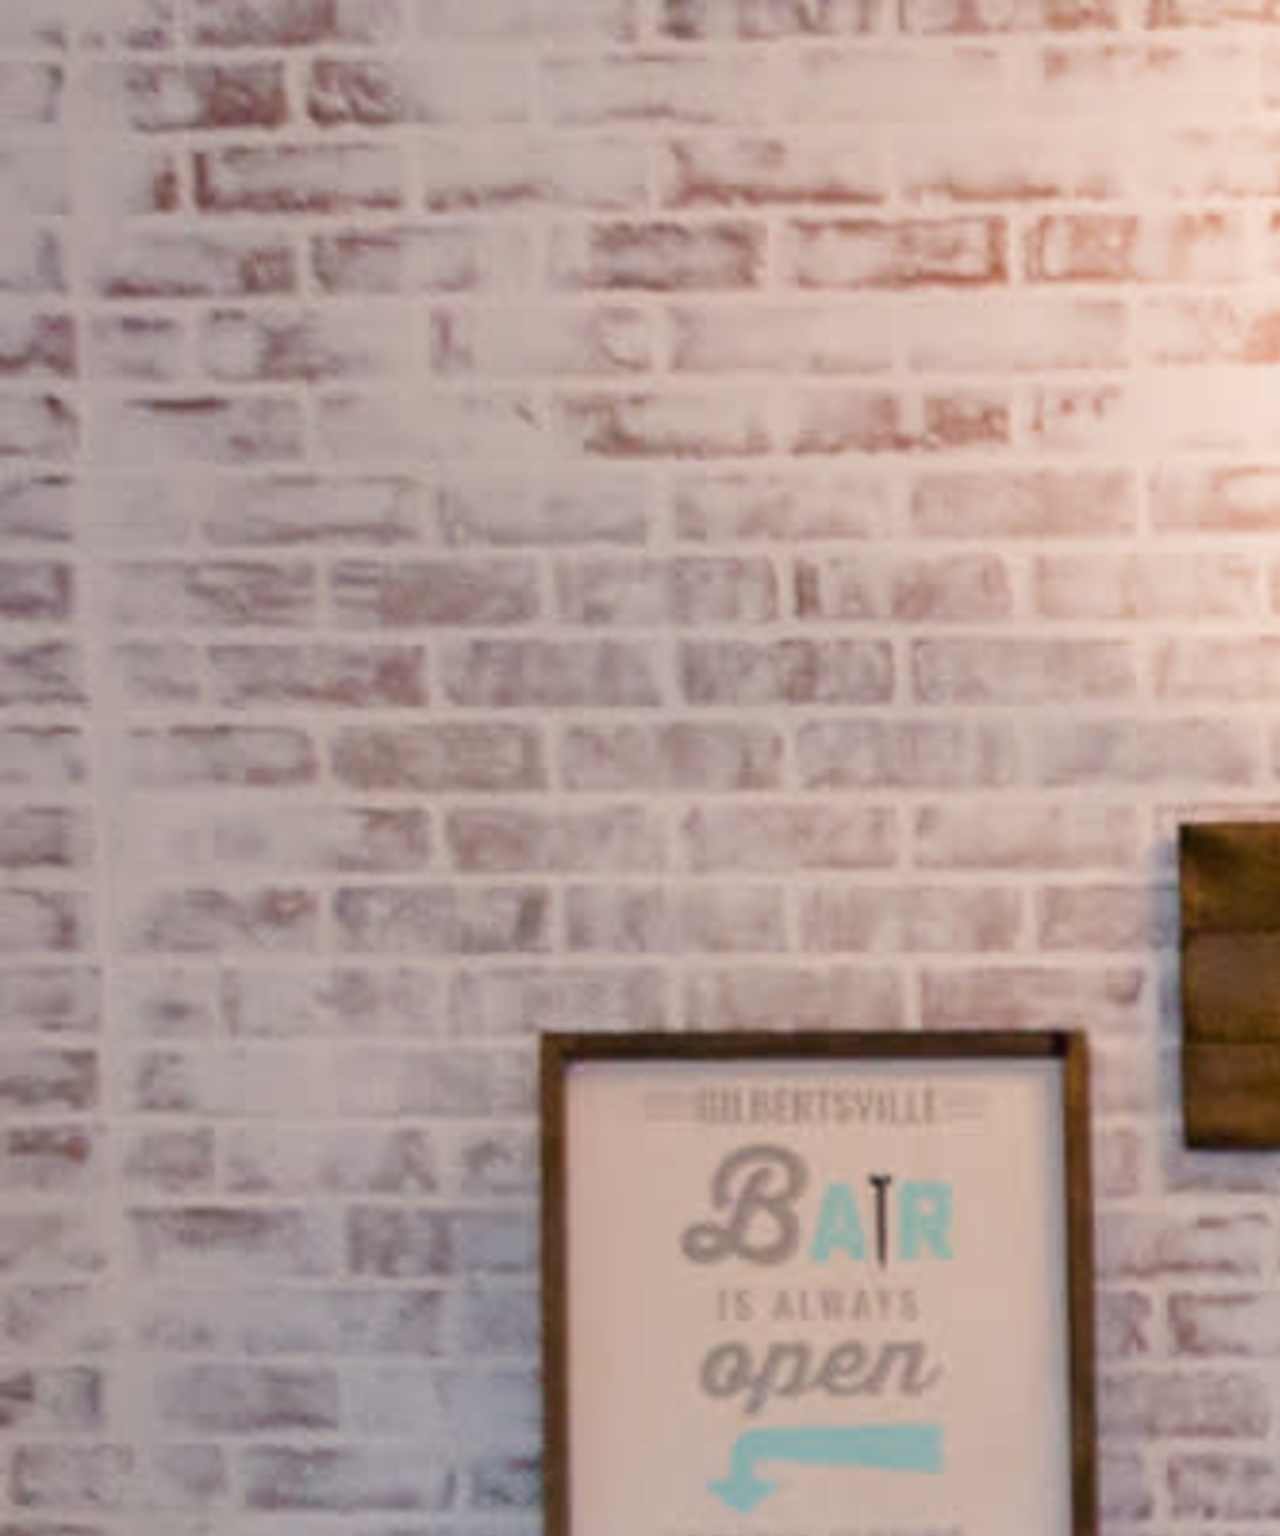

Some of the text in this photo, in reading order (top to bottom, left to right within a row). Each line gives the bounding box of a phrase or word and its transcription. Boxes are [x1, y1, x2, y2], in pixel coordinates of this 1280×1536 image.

[717, 1289, 919, 1322] IS ALWAYS
[699, 1341, 946, 1414] open
